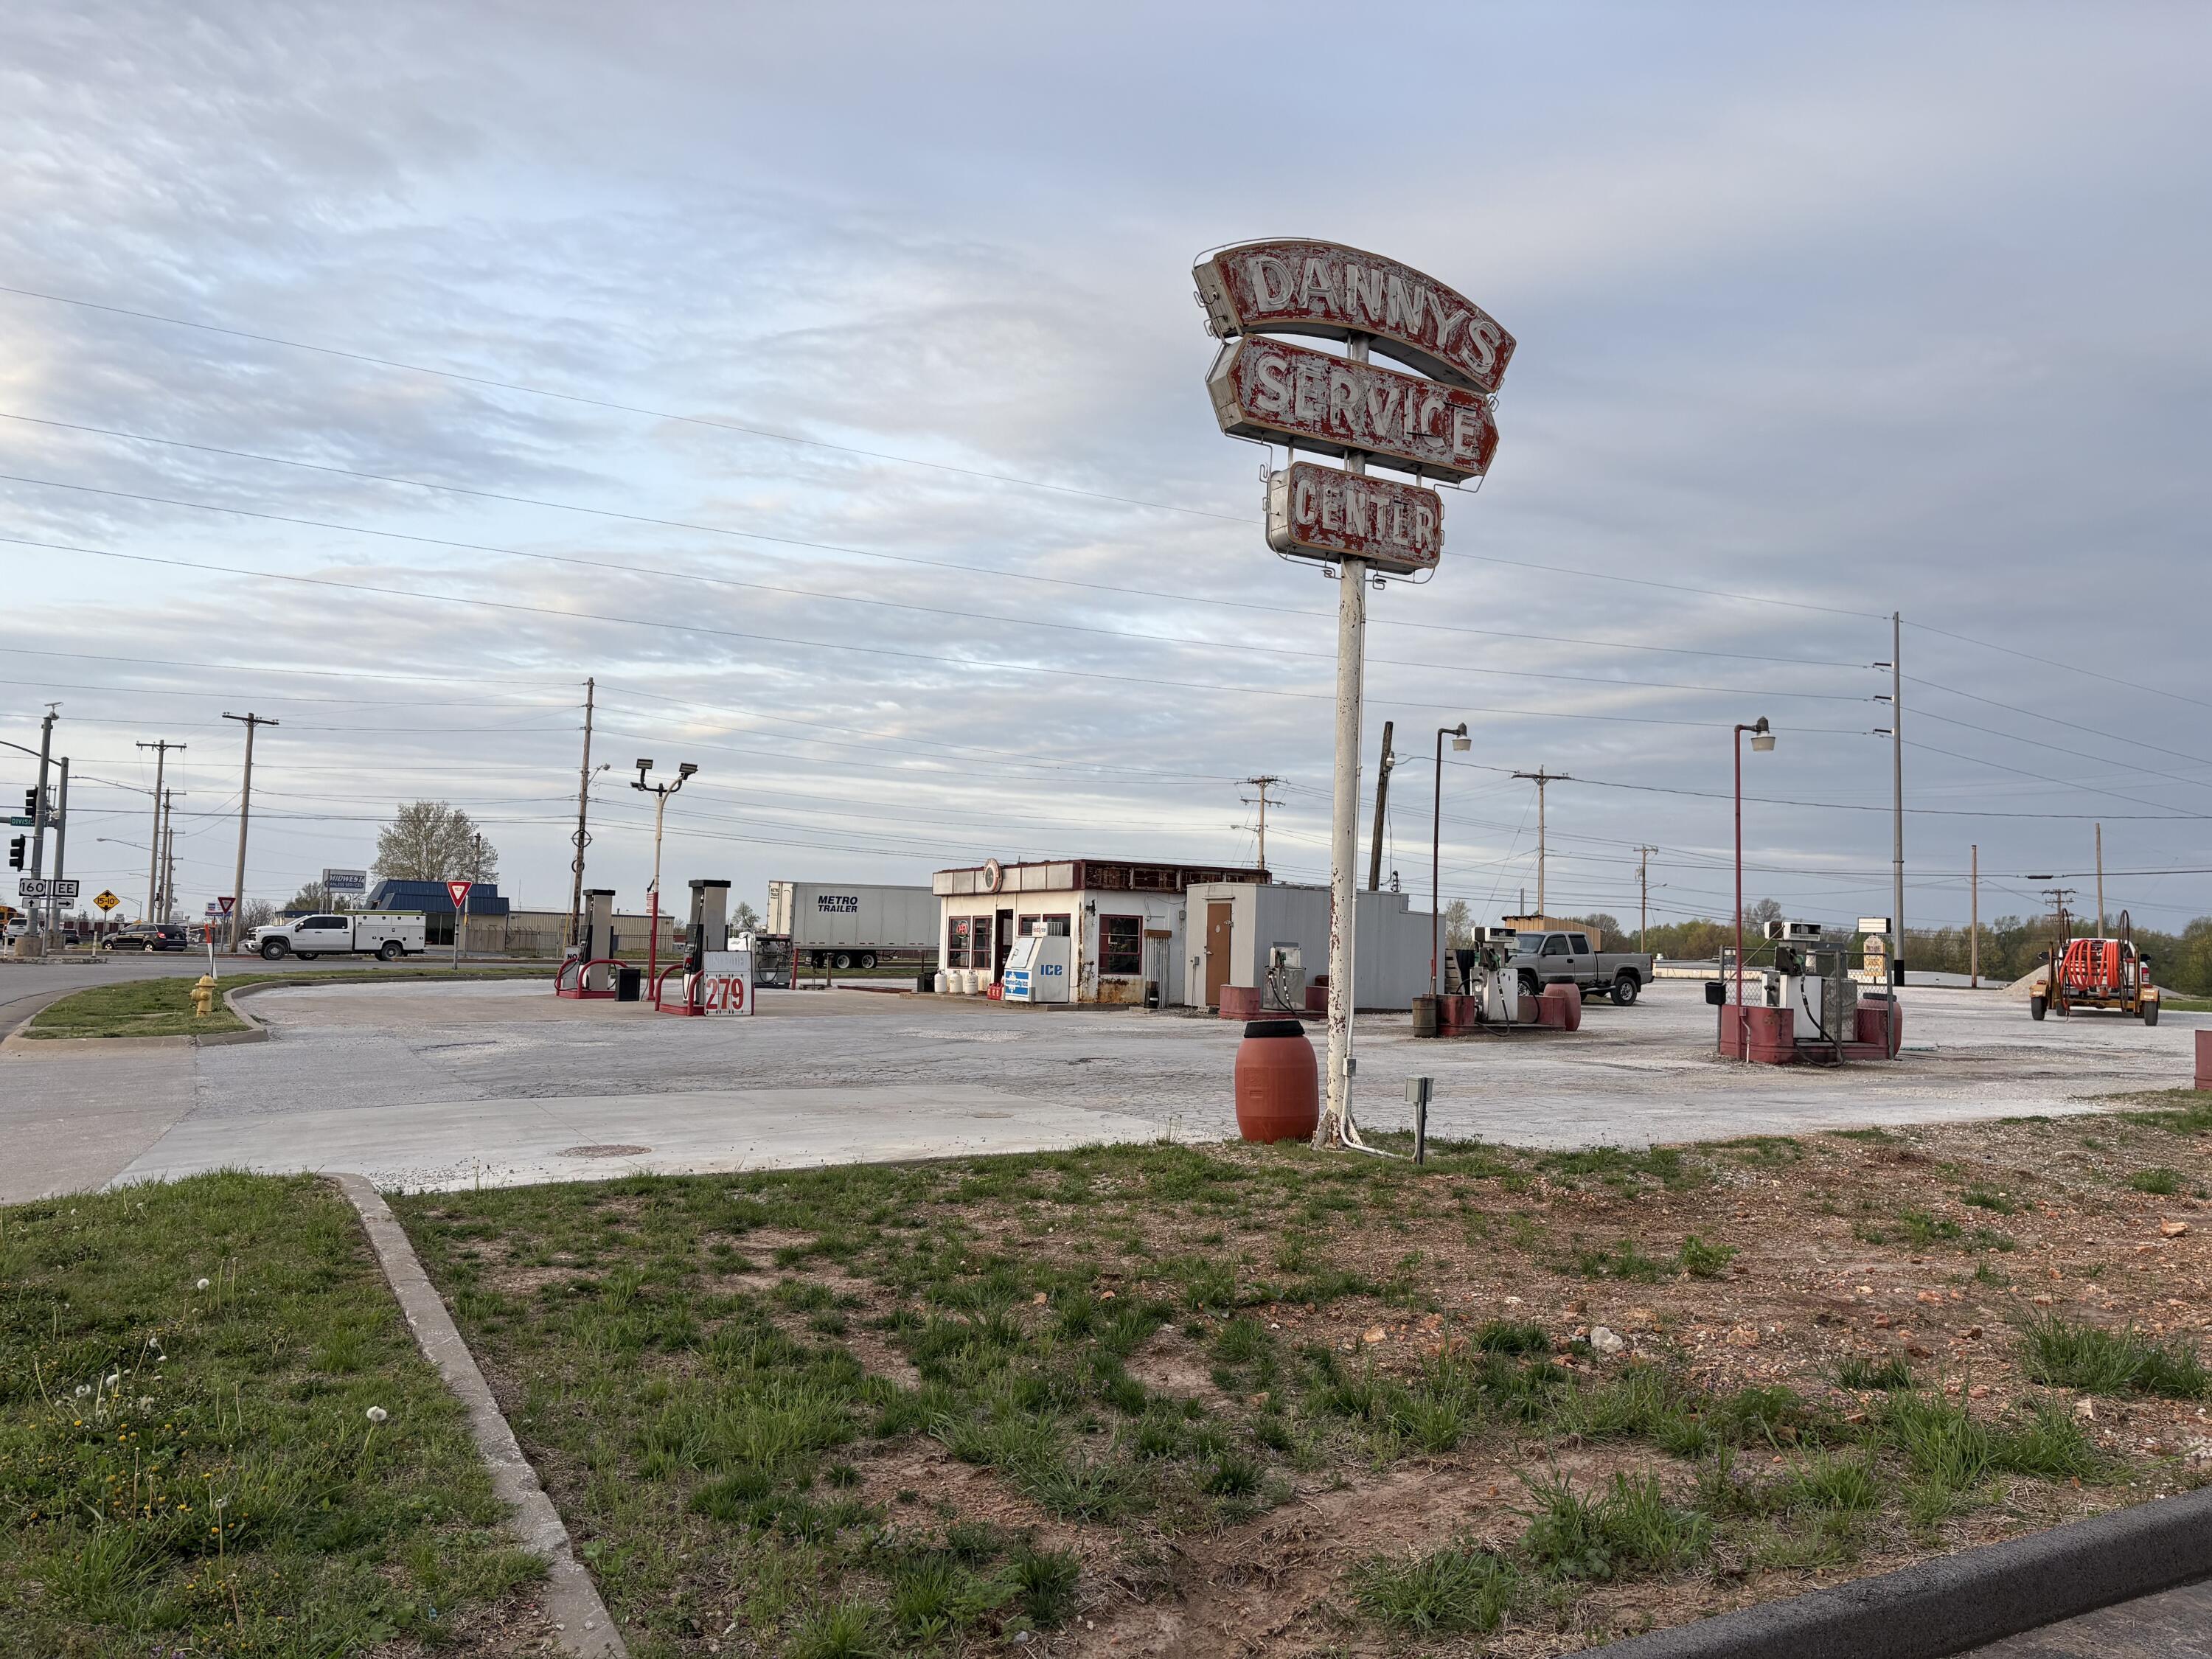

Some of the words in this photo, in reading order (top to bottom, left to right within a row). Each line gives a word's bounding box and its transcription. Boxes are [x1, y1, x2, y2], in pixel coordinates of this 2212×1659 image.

[1248, 256, 1501, 375] DANNYS
[1254, 355, 1478, 457] SERVICE
[1295, 479, 1436, 552] CENTER
[21, 883, 44, 893] 160
[58, 884, 74, 893] EE
[818, 895, 858, 905] METRO
[818, 905, 858, 913] TRAILER
[706, 978, 744, 1009] 279
